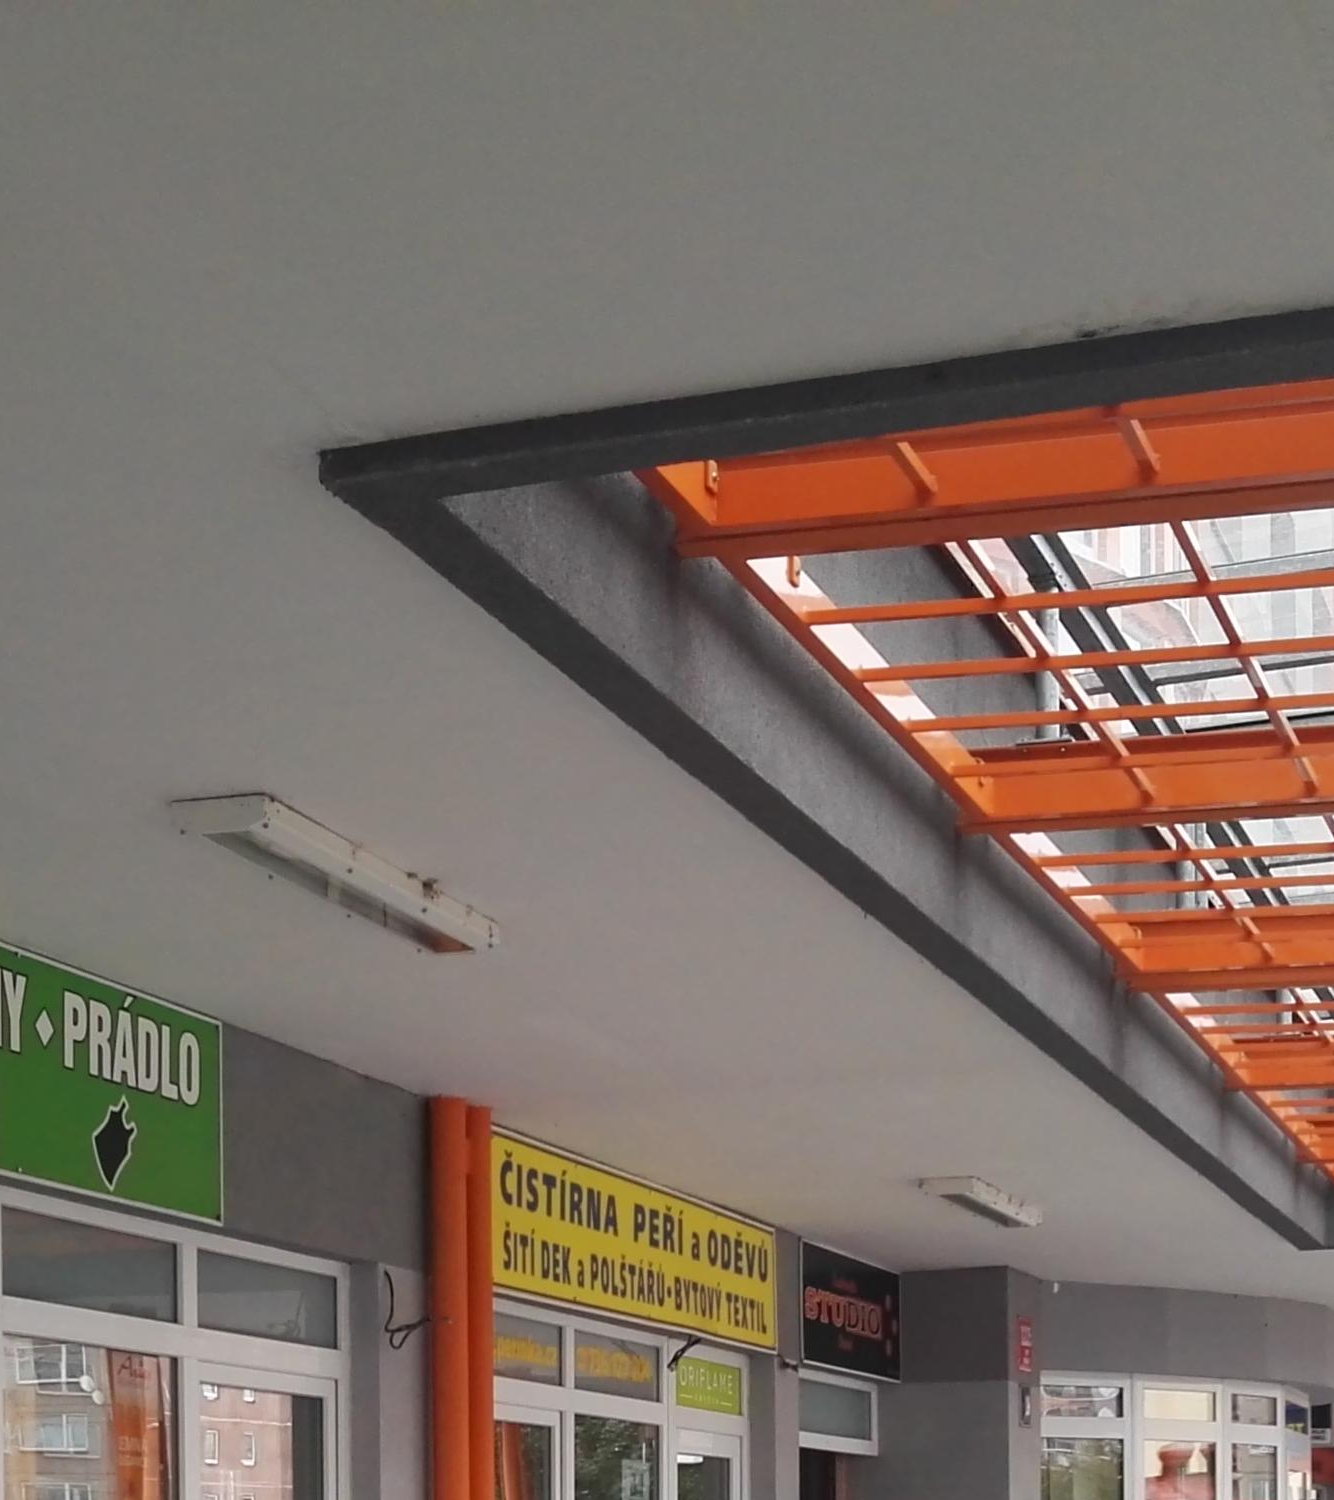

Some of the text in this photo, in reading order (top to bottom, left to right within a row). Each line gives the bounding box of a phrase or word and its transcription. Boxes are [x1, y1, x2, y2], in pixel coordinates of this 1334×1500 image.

[61, 989, 203, 1107] PRÁDLO
[499, 1149, 768, 1283] ČISTÍRNA PEŘÍ a ODĚVŮ
[503, 1222, 768, 1335] ŠITÍ DEK a POLŠTÁŘŮ BYTOVÝ TEXTIL
[804, 1285, 883, 1340] STUDIO
[679, 1364, 734, 1395] ORIFLAME
